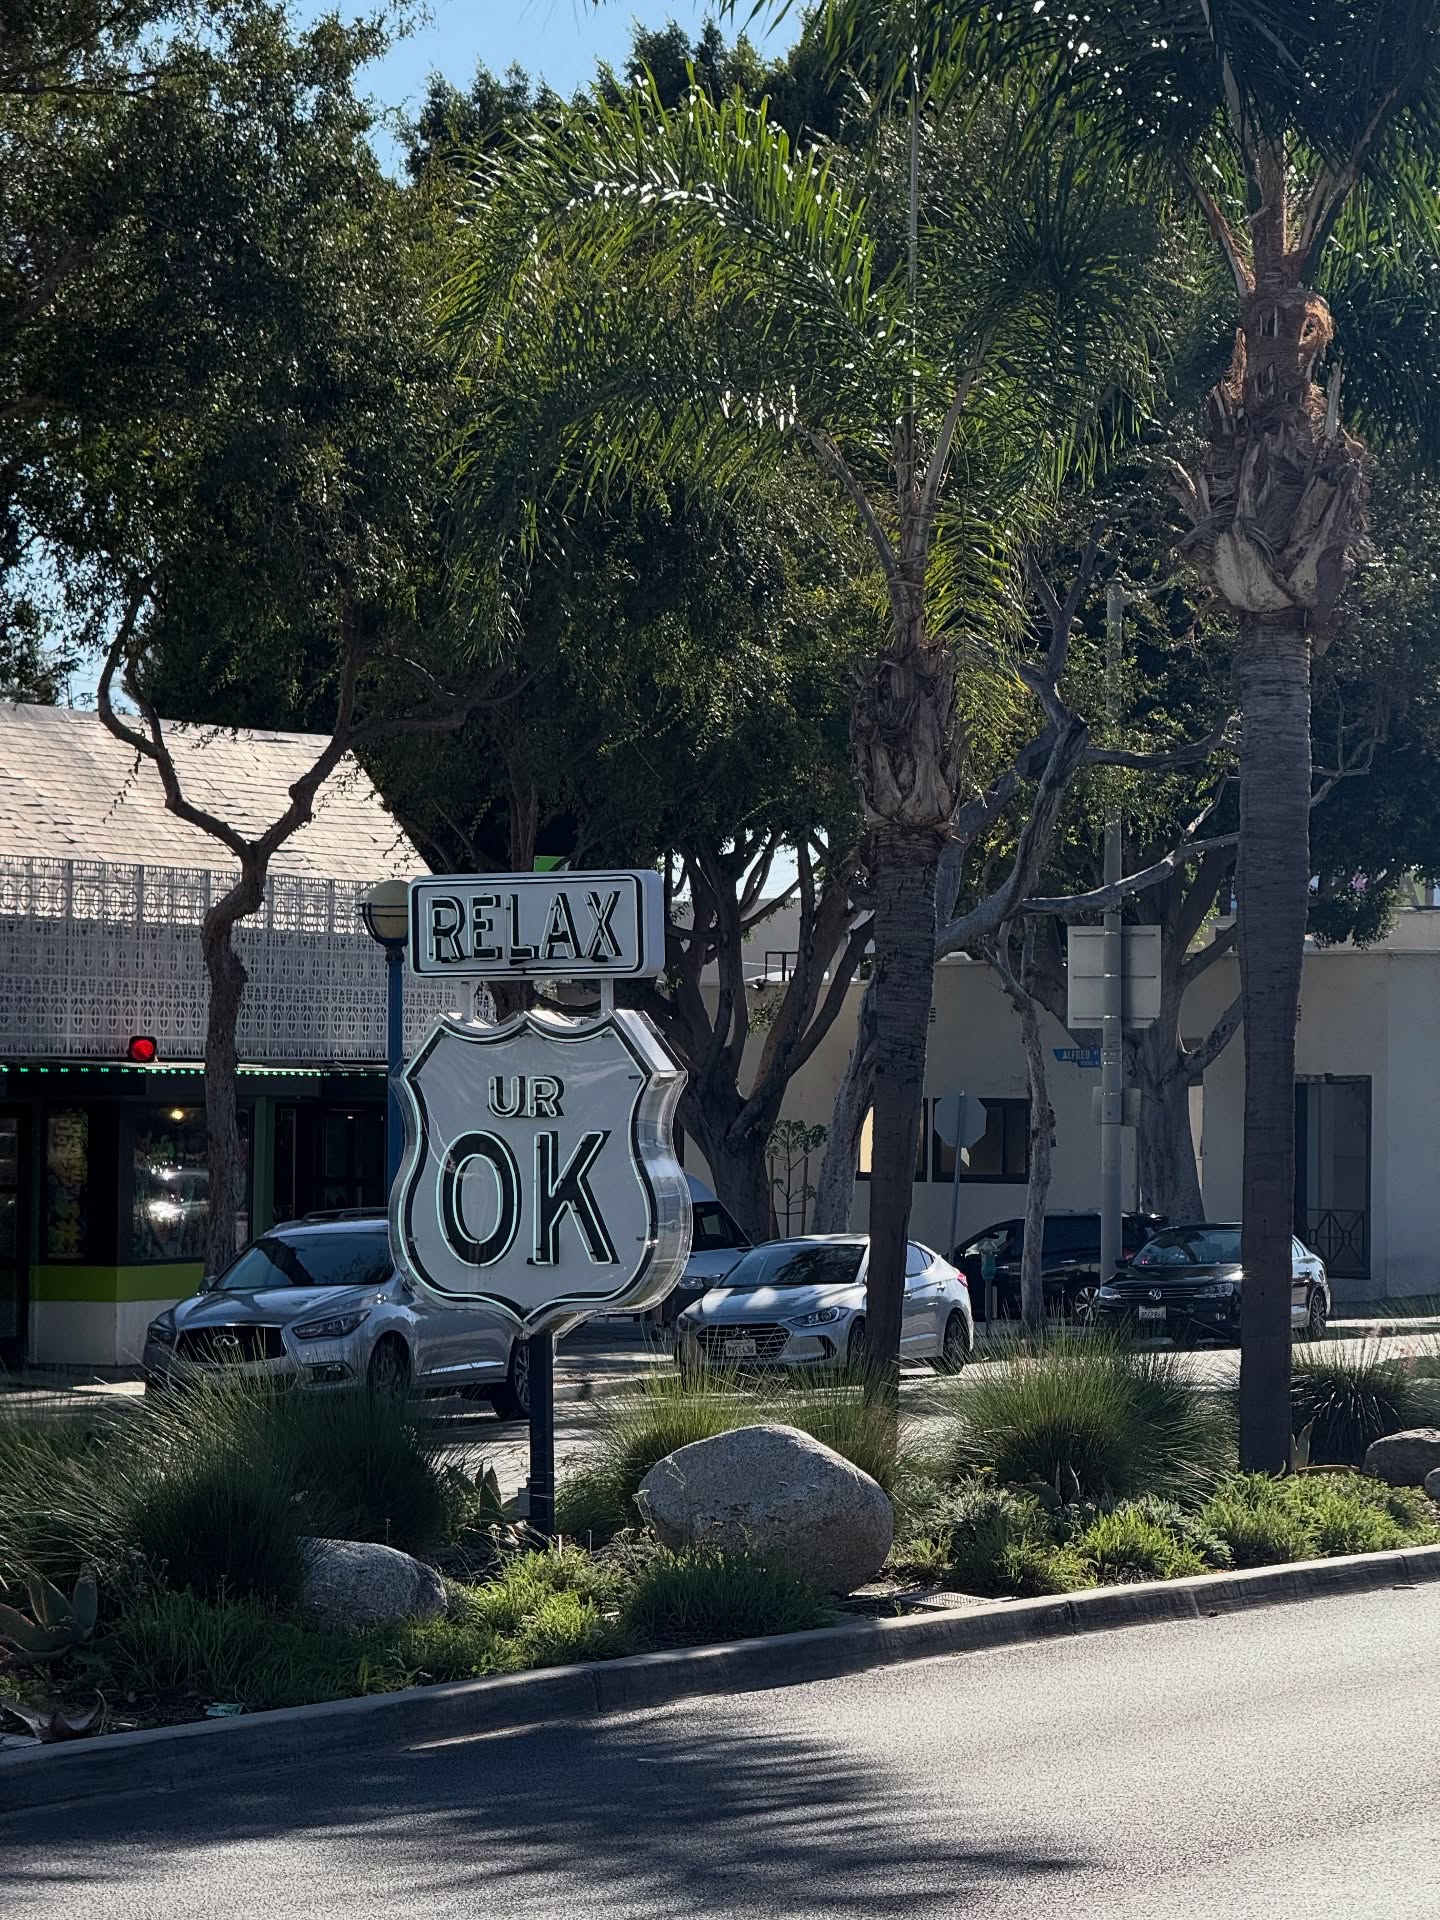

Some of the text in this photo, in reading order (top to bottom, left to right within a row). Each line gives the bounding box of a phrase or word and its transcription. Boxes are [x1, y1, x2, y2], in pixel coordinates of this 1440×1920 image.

[426, 891, 622, 963] RELAX
[1062, 1049, 1090, 1060] ALFRED
[487, 1074, 565, 1118] UR
[436, 1130, 620, 1267] OK
